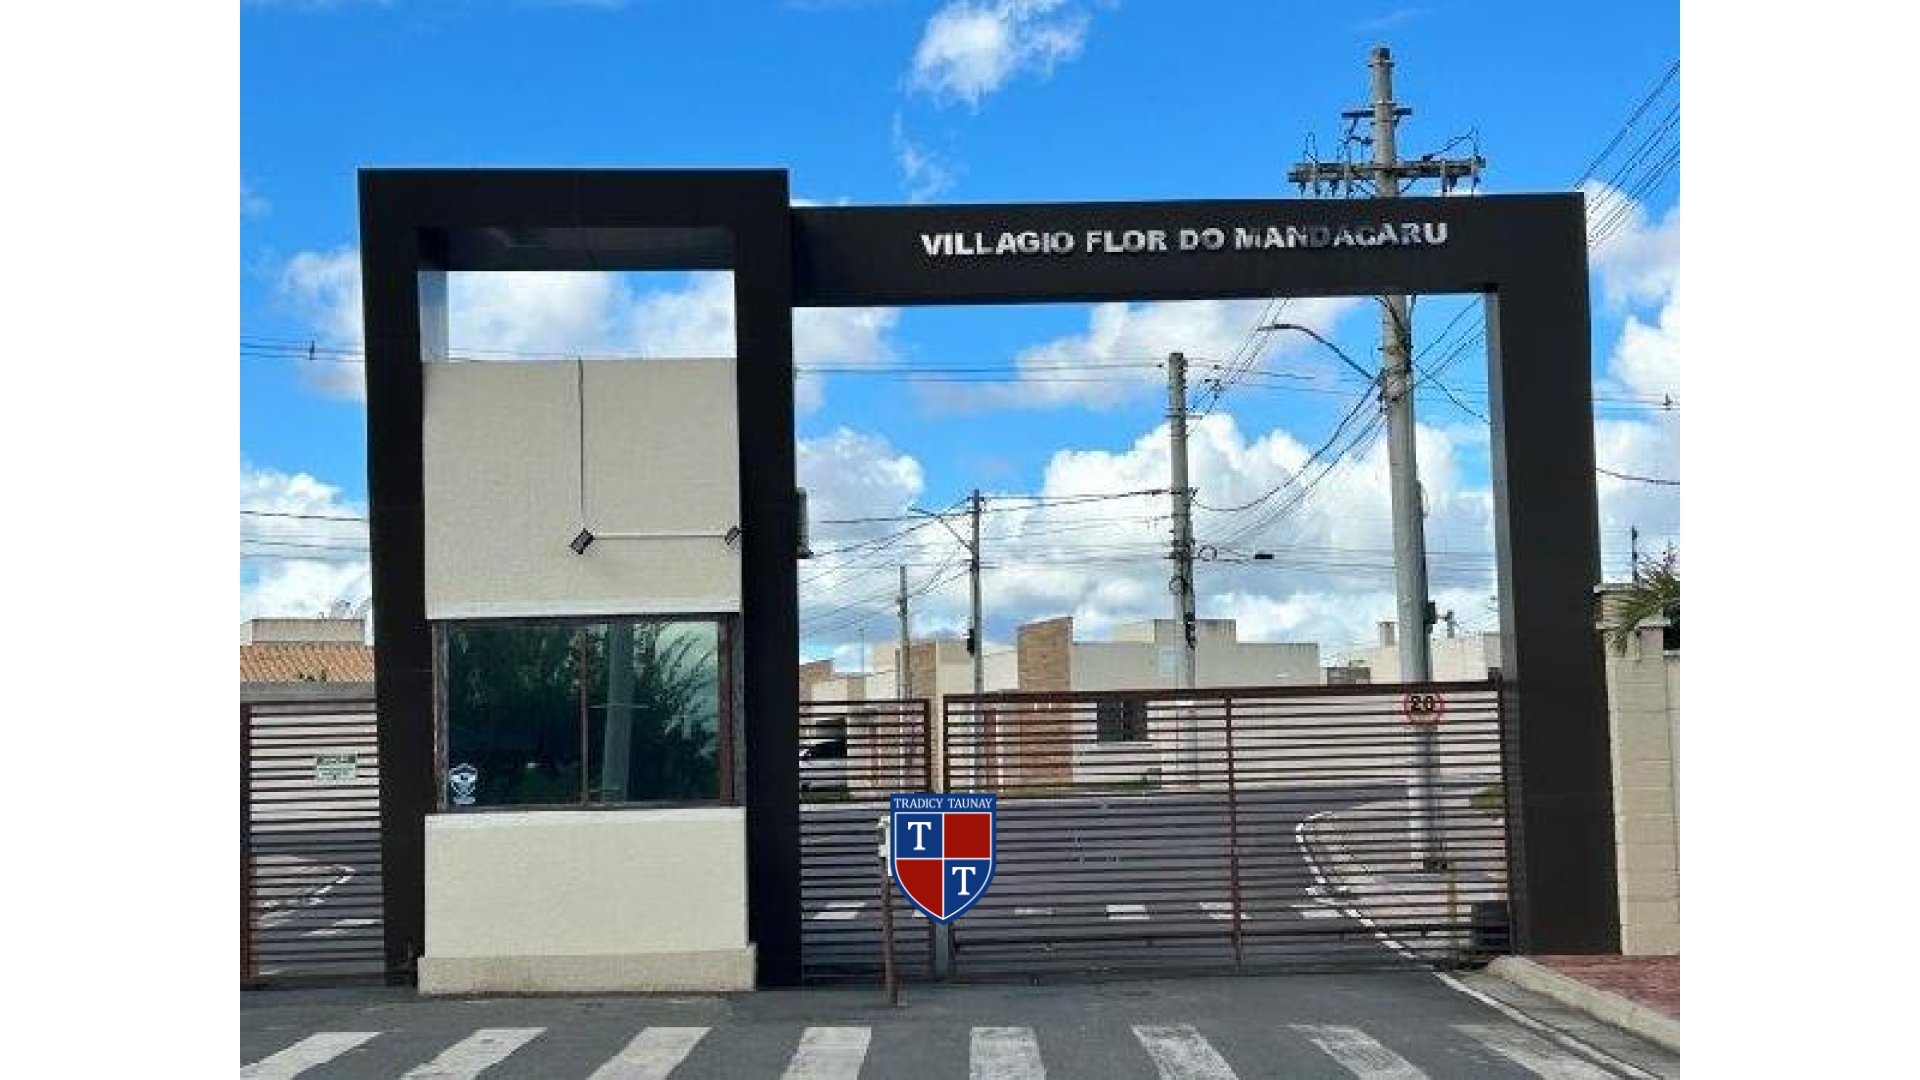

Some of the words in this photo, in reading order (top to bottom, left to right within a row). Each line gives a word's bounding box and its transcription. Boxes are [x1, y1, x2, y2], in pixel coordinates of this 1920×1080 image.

[920, 229, 1076, 256] VILLAGIO
[1086, 229, 1168, 253] FLOR
[1179, 227, 1226, 250] DO
[1234, 222, 1449, 249] MANDACARU
